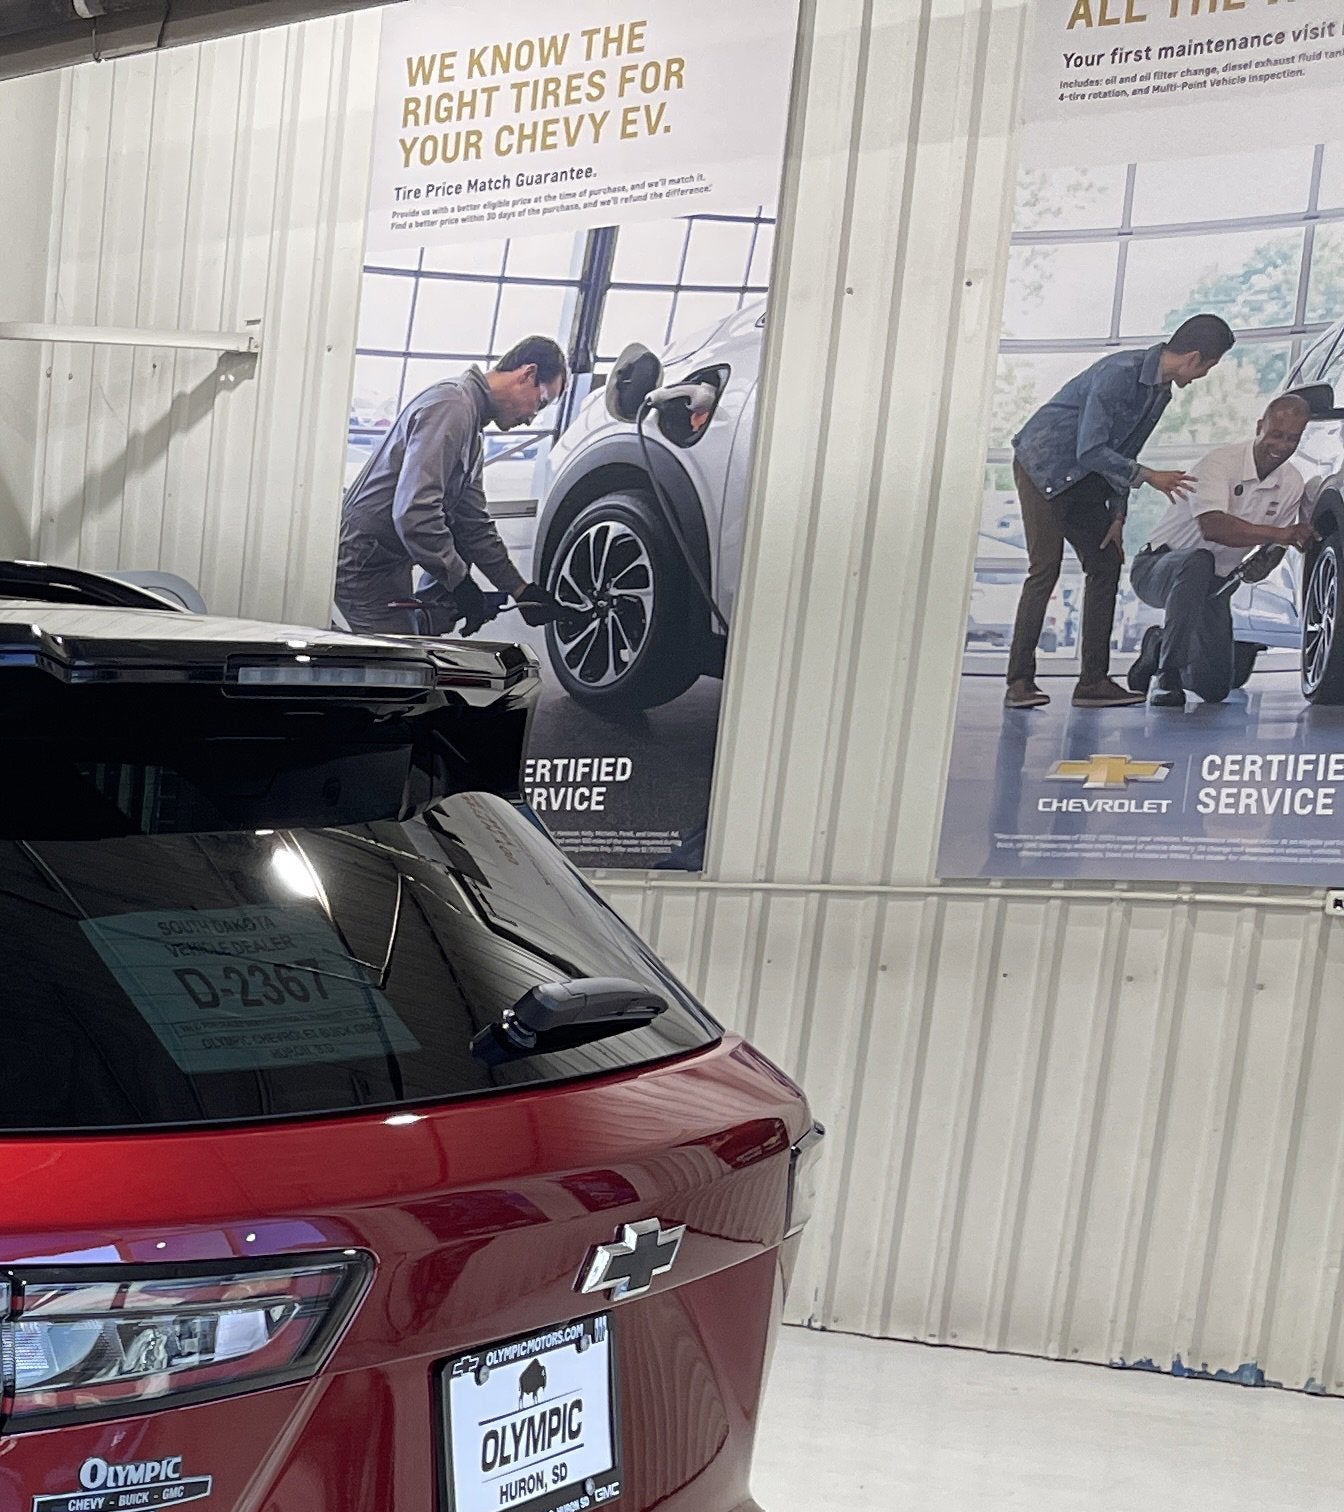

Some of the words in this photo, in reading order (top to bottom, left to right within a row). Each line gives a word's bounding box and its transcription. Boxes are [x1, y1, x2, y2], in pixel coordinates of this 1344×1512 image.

[406, 50, 458, 87] WE
[467, 33, 570, 78] KNOW
[581, 20, 648, 61] THE
[1062, 52, 1105, 69] Your
[1110, 44, 1152, 65] first
[1158, 30, 1286, 60] maintenance
[1291, 20, 1336, 43] visit
[1059, 77, 1104, 89] Includes:
[1105, 75, 1117, 86] oil
[1119, 73, 1137, 85] and
[1139, 71, 1151, 82] oil
[1152, 67, 1178, 81] filter
[1180, 65, 1220, 80] change,
[1221, 60, 1253, 74] diesel
[1254, 54, 1295, 68] exhaust
[1298, 50, 1322, 64] fluid
[401, 86, 500, 128] RIGHT
[511, 69, 606, 113] TIRES
[617, 57, 685, 98] FOR
[1058, 90, 1086, 101] 4-tire
[1087, 86, 1129, 100] rotation,
[1131, 84, 1150, 95] and
[1152, 79, 1207, 94] Multi-Point
[1210, 75, 1246, 89] Vehicle
[398, 127, 482, 169] YOUR
[493, 111, 610, 158] CHEVY
[619, 102, 672, 141] EV.
[391, 209, 420, 219] Provide
[421, 207, 431, 216] us
[431, 203, 449, 215] with
[457, 201, 481, 213] better
[483, 197, 510, 211] eligible
[511, 195, 532, 210] price
[533, 194, 543, 204] at
[543, 192, 557, 203] the
[559, 189, 577, 201] time
[578, 188, 588, 199] of
[588, 184, 628, 199] purchase,
[630, 180, 646, 192] and
[647, 177, 666, 189] we'll
[668, 174, 695, 188] match
[696, 173, 706, 183] it.
[393, 185, 422, 202] Tire
[425, 181, 462, 199] Price
[466, 175, 511, 194] Match
[515, 166, 598, 188] Guarantee.
[390, 220, 407, 231] Find
[414, 217, 438, 230] better
[439, 216, 459, 229] price
[460, 212, 485, 225] within
[486, 210, 497, 221] 30
[497, 208, 516, 222] days
[517, 207, 527, 218] of
[527, 206, 541, 217] the
[542, 201, 581, 216] purchase,
[583, 198, 598, 209] and
[620, 190, 648, 204] refund
[649, 189, 663, 200] the
[524, 756, 633, 783] ERTIFIED
[1201, 753, 1344, 783] CERTIFIE
[525, 786, 607, 812] RVICE
[1037, 798, 1172, 814] CHEVROLET
[1196, 787, 1336, 816] SERVICE
[158, 920, 211, 938] SOUTH
[211, 916, 276, 935] DAKOTA
[163, 940, 230, 959] VEHICLE
[231, 935, 295, 956] DEALER
[173, 958, 331, 1010] D-2367
[485, 1323, 584, 1367] OLYMPICMOTORS.COM
[480, 1398, 583, 1473] OLYMPIC
[79, 1455, 183, 1490] OLYMPIC
[499, 1469, 549, 1505] HURON,
[551, 1461, 568, 1485] SD
[67, 1497, 105, 1512] CHEVY
[118, 1492, 150, 1508] BUICK
[162, 1485, 185, 1500] GMC
[594, 1481, 620, 1503] GMC
